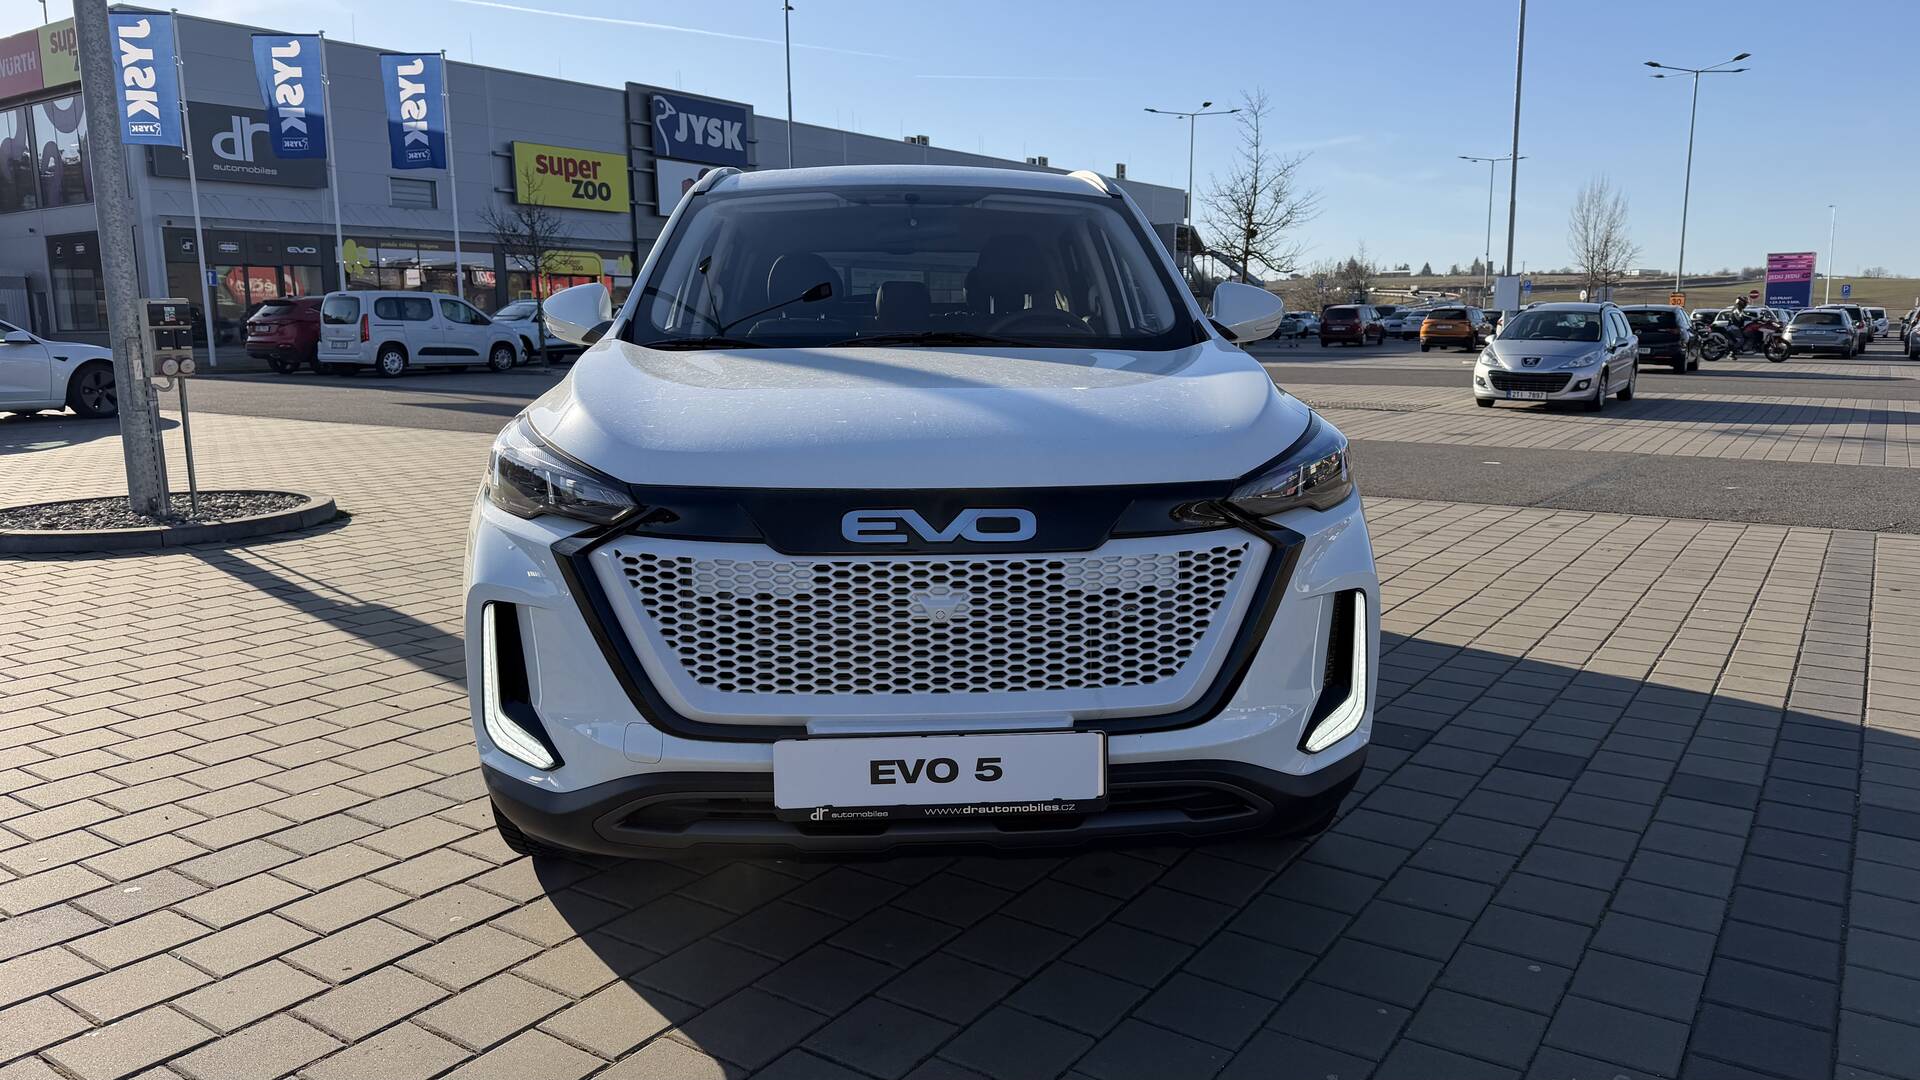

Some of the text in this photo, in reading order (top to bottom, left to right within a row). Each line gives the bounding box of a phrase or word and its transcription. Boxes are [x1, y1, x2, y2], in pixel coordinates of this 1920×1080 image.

[50, 27, 77, 56] sup
[211, 115, 270, 163] dr
[674, 112, 744, 151] JYSK
[213, 164, 278, 175] automobiles
[535, 154, 602, 182] super
[287, 246, 317, 254] EVO
[1843, 285, 1850, 293] P
[841, 508, 1037, 543] EVO
[869, 757, 1003, 785] EVO 5
[810, 804, 1076, 821] dr automobiles www.drautomobiles.cz
